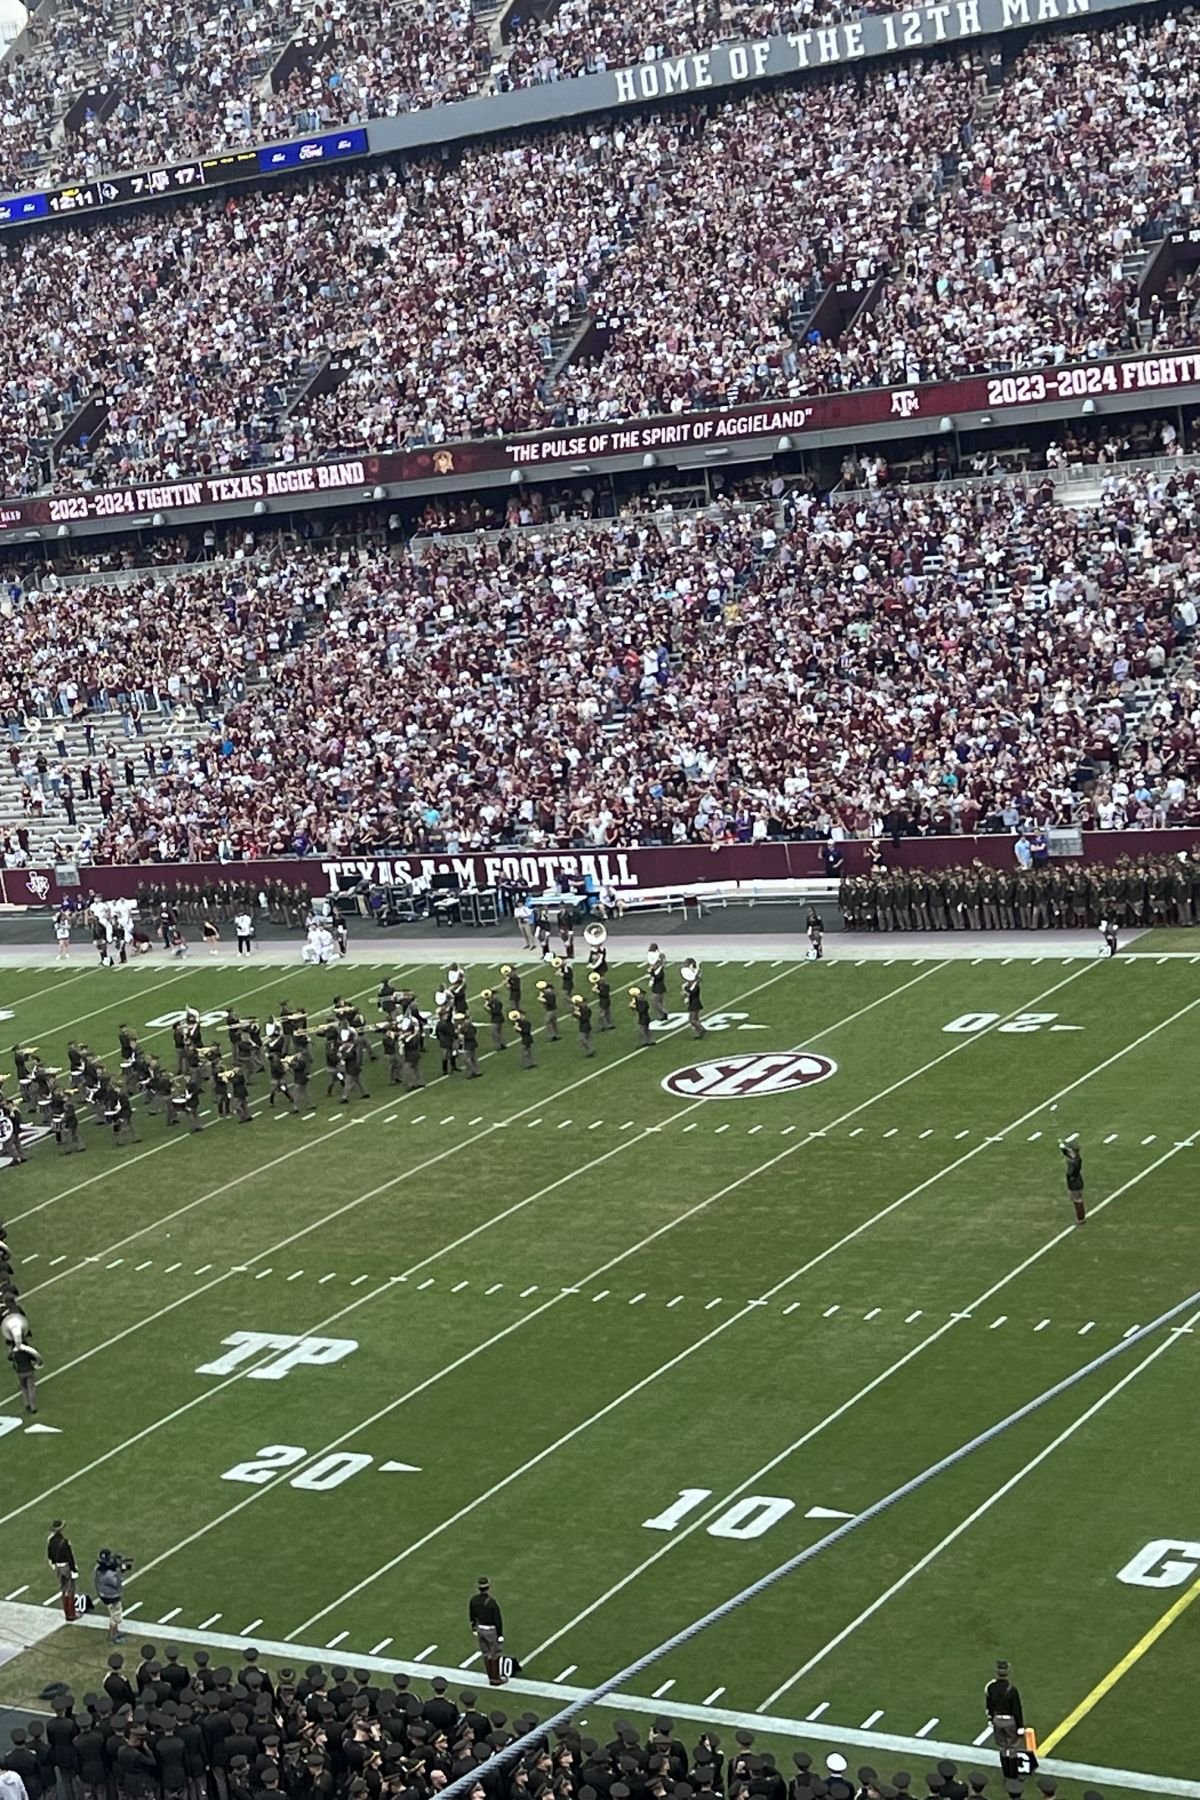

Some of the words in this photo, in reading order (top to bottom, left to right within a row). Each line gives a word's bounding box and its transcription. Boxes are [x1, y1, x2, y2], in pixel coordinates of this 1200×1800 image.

[614, 54, 712, 102] HOME
[729, 42, 771, 81] OF
[787, 22, 865, 67] THE
[882, 0, 981, 50] 12TH
[298, 143, 324, 160] Ford
[130, 178, 144, 193] 7
[174, 168, 196, 184] 17
[50, 191, 94, 211] 12:11
[987, 365, 1118, 405] 2023-2024
[506, 443, 540, 462] "THE
[541, 437, 587, 458] PULSE
[589, 434, 608, 452] OF
[611, 430, 640, 450] THE
[642, 424, 690, 446] SPIRIT
[695, 421, 713, 439] OF
[716, 407, 813, 436] AGGIELAND"
[49, 491, 135, 521] 2023-2024
[136, 482, 203, 510] FIGHTIN'
[207, 474, 263, 501] TEXAS
[266, 468, 315, 494] AGGIE
[316, 462, 365, 488] BAND
[321, 861, 413, 892] TEXAS
[484, 853, 639, 888] FOOTBALL
[673, 1055, 824, 1095] SEC
[195, 1329, 360, 1380] TP
[220, 1444, 375, 1491] 20
[641, 1488, 796, 1540] 10
[1116, 1539, 1200, 1588] G
[73, 1594, 87, 1613] 20
[498, 1656, 513, 1677] 10
